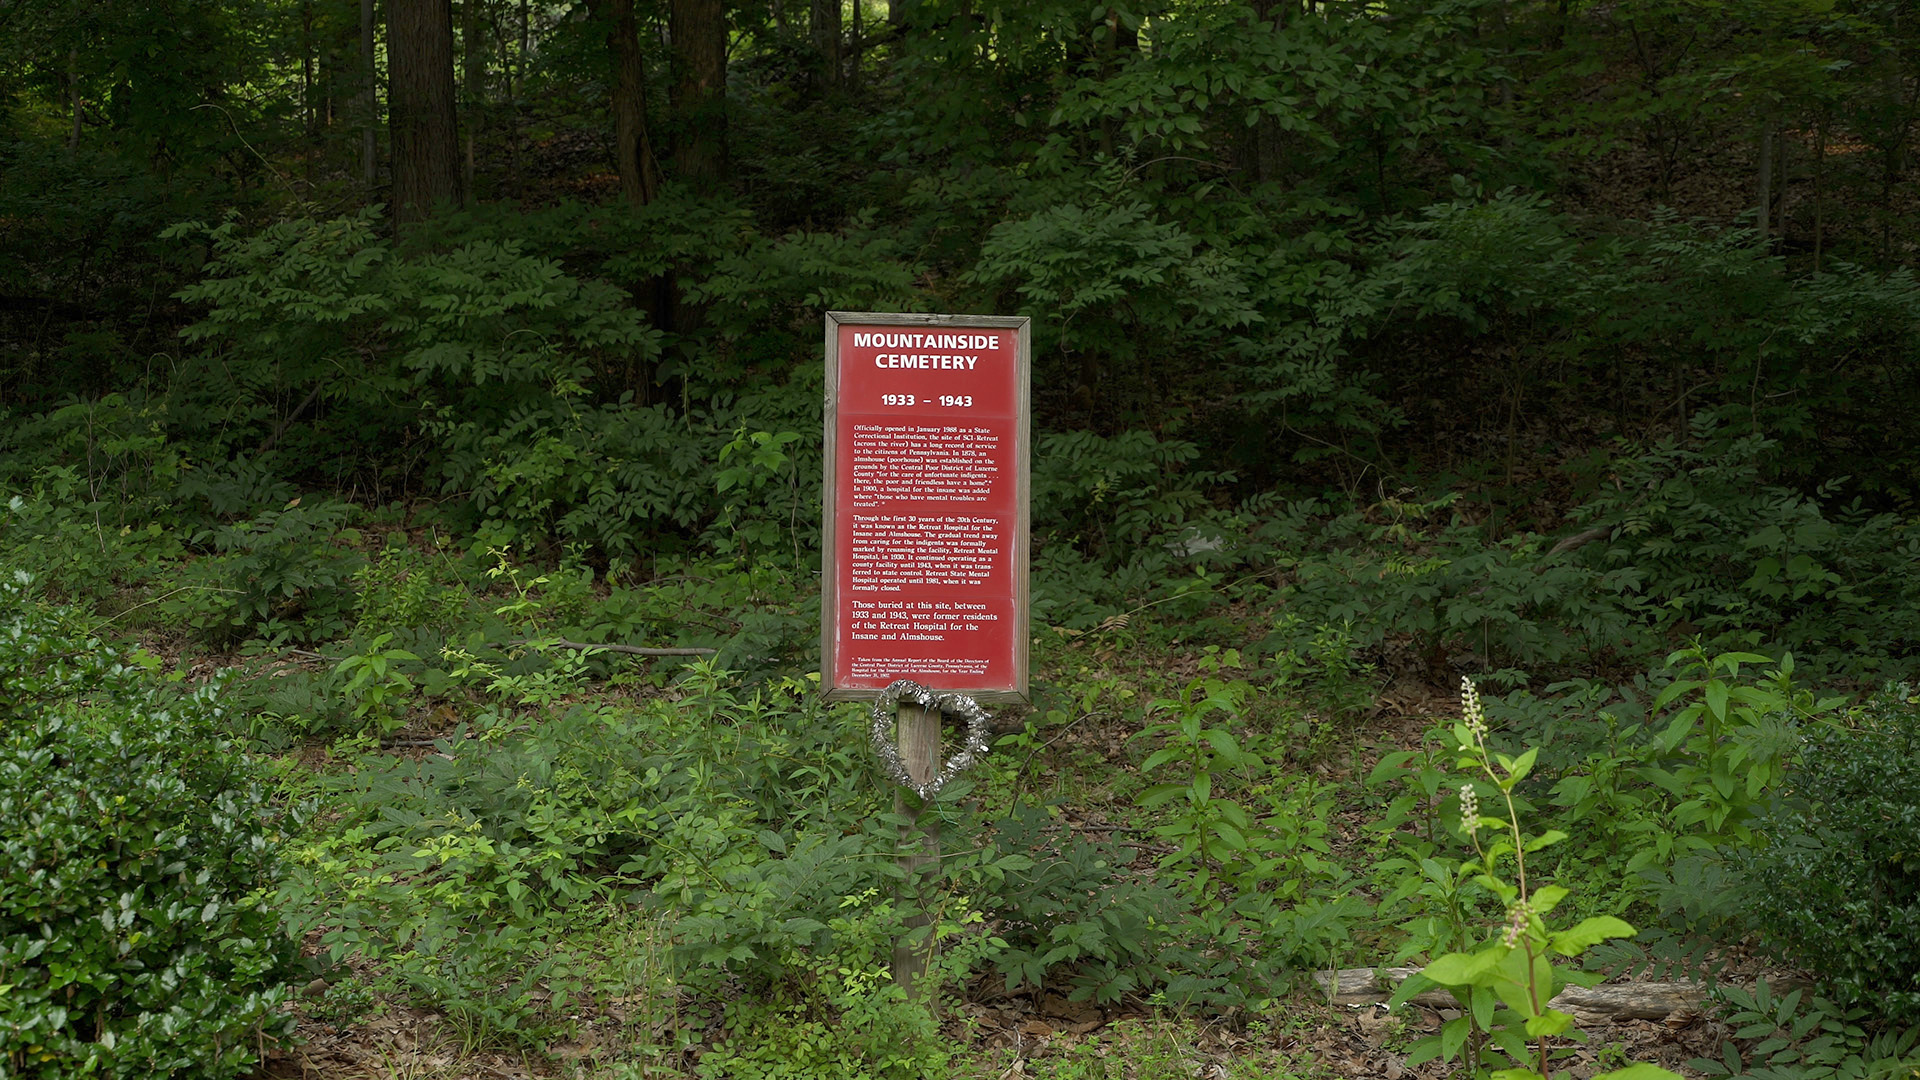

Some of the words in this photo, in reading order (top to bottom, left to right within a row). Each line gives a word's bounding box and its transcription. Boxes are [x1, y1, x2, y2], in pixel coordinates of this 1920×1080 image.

[854, 333, 999, 349] MOUNTAINSIDE
[875, 354, 978, 369] CEMETERY
[881, 394, 915, 405] 1933
[939, 395, 972, 406] 1943
[854, 424, 882, 433] Officially
[884, 425, 906, 434] opened
[916, 425, 941, 434] January
[929, 441, 943, 450] long
[854, 463, 878, 471] grounds
[853, 470, 874, 478] County
[960, 472, 987, 480] indigents
[886, 485, 911, 494] hospital
[853, 514, 879, 523] Through
[944, 524, 969, 532] Hospital
[938, 531, 962, 540] gradual
[870, 538, 890, 546] caring
[916, 539, 944, 547] indigents
[960, 540, 986, 548] formally
[886, 546, 915, 555] renaming
[947, 554, 977, 563] operating
[852, 560, 874, 569] county
[876, 561, 898, 570] facility
[852, 576, 878, 585] Hospital
[880, 576, 906, 585] operated
[852, 584, 878, 593] formally
[852, 599, 875, 608] Those
[878, 600, 903, 609] buried
[906, 600, 914, 609] at
[918, 600, 932, 609] this
[935, 600, 952, 611] site,
[954, 601, 986, 610] between
[852, 609, 869, 618] 1933
[872, 609, 886, 619] and
[890, 609, 909, 620] 1943,
[933, 610, 960, 620] former
[963, 611, 998, 620] residents
[851, 619, 860, 629] of
[864, 619, 877, 629] the
[880, 620, 910, 630] Retreat
[913, 620, 947, 633] Hospital
[950, 621, 963, 631] for
[966, 621, 978, 631] the
[852, 631, 878, 640] Insane
[881, 632, 896, 640] and
[900, 632, 944, 641] Almshouse.
